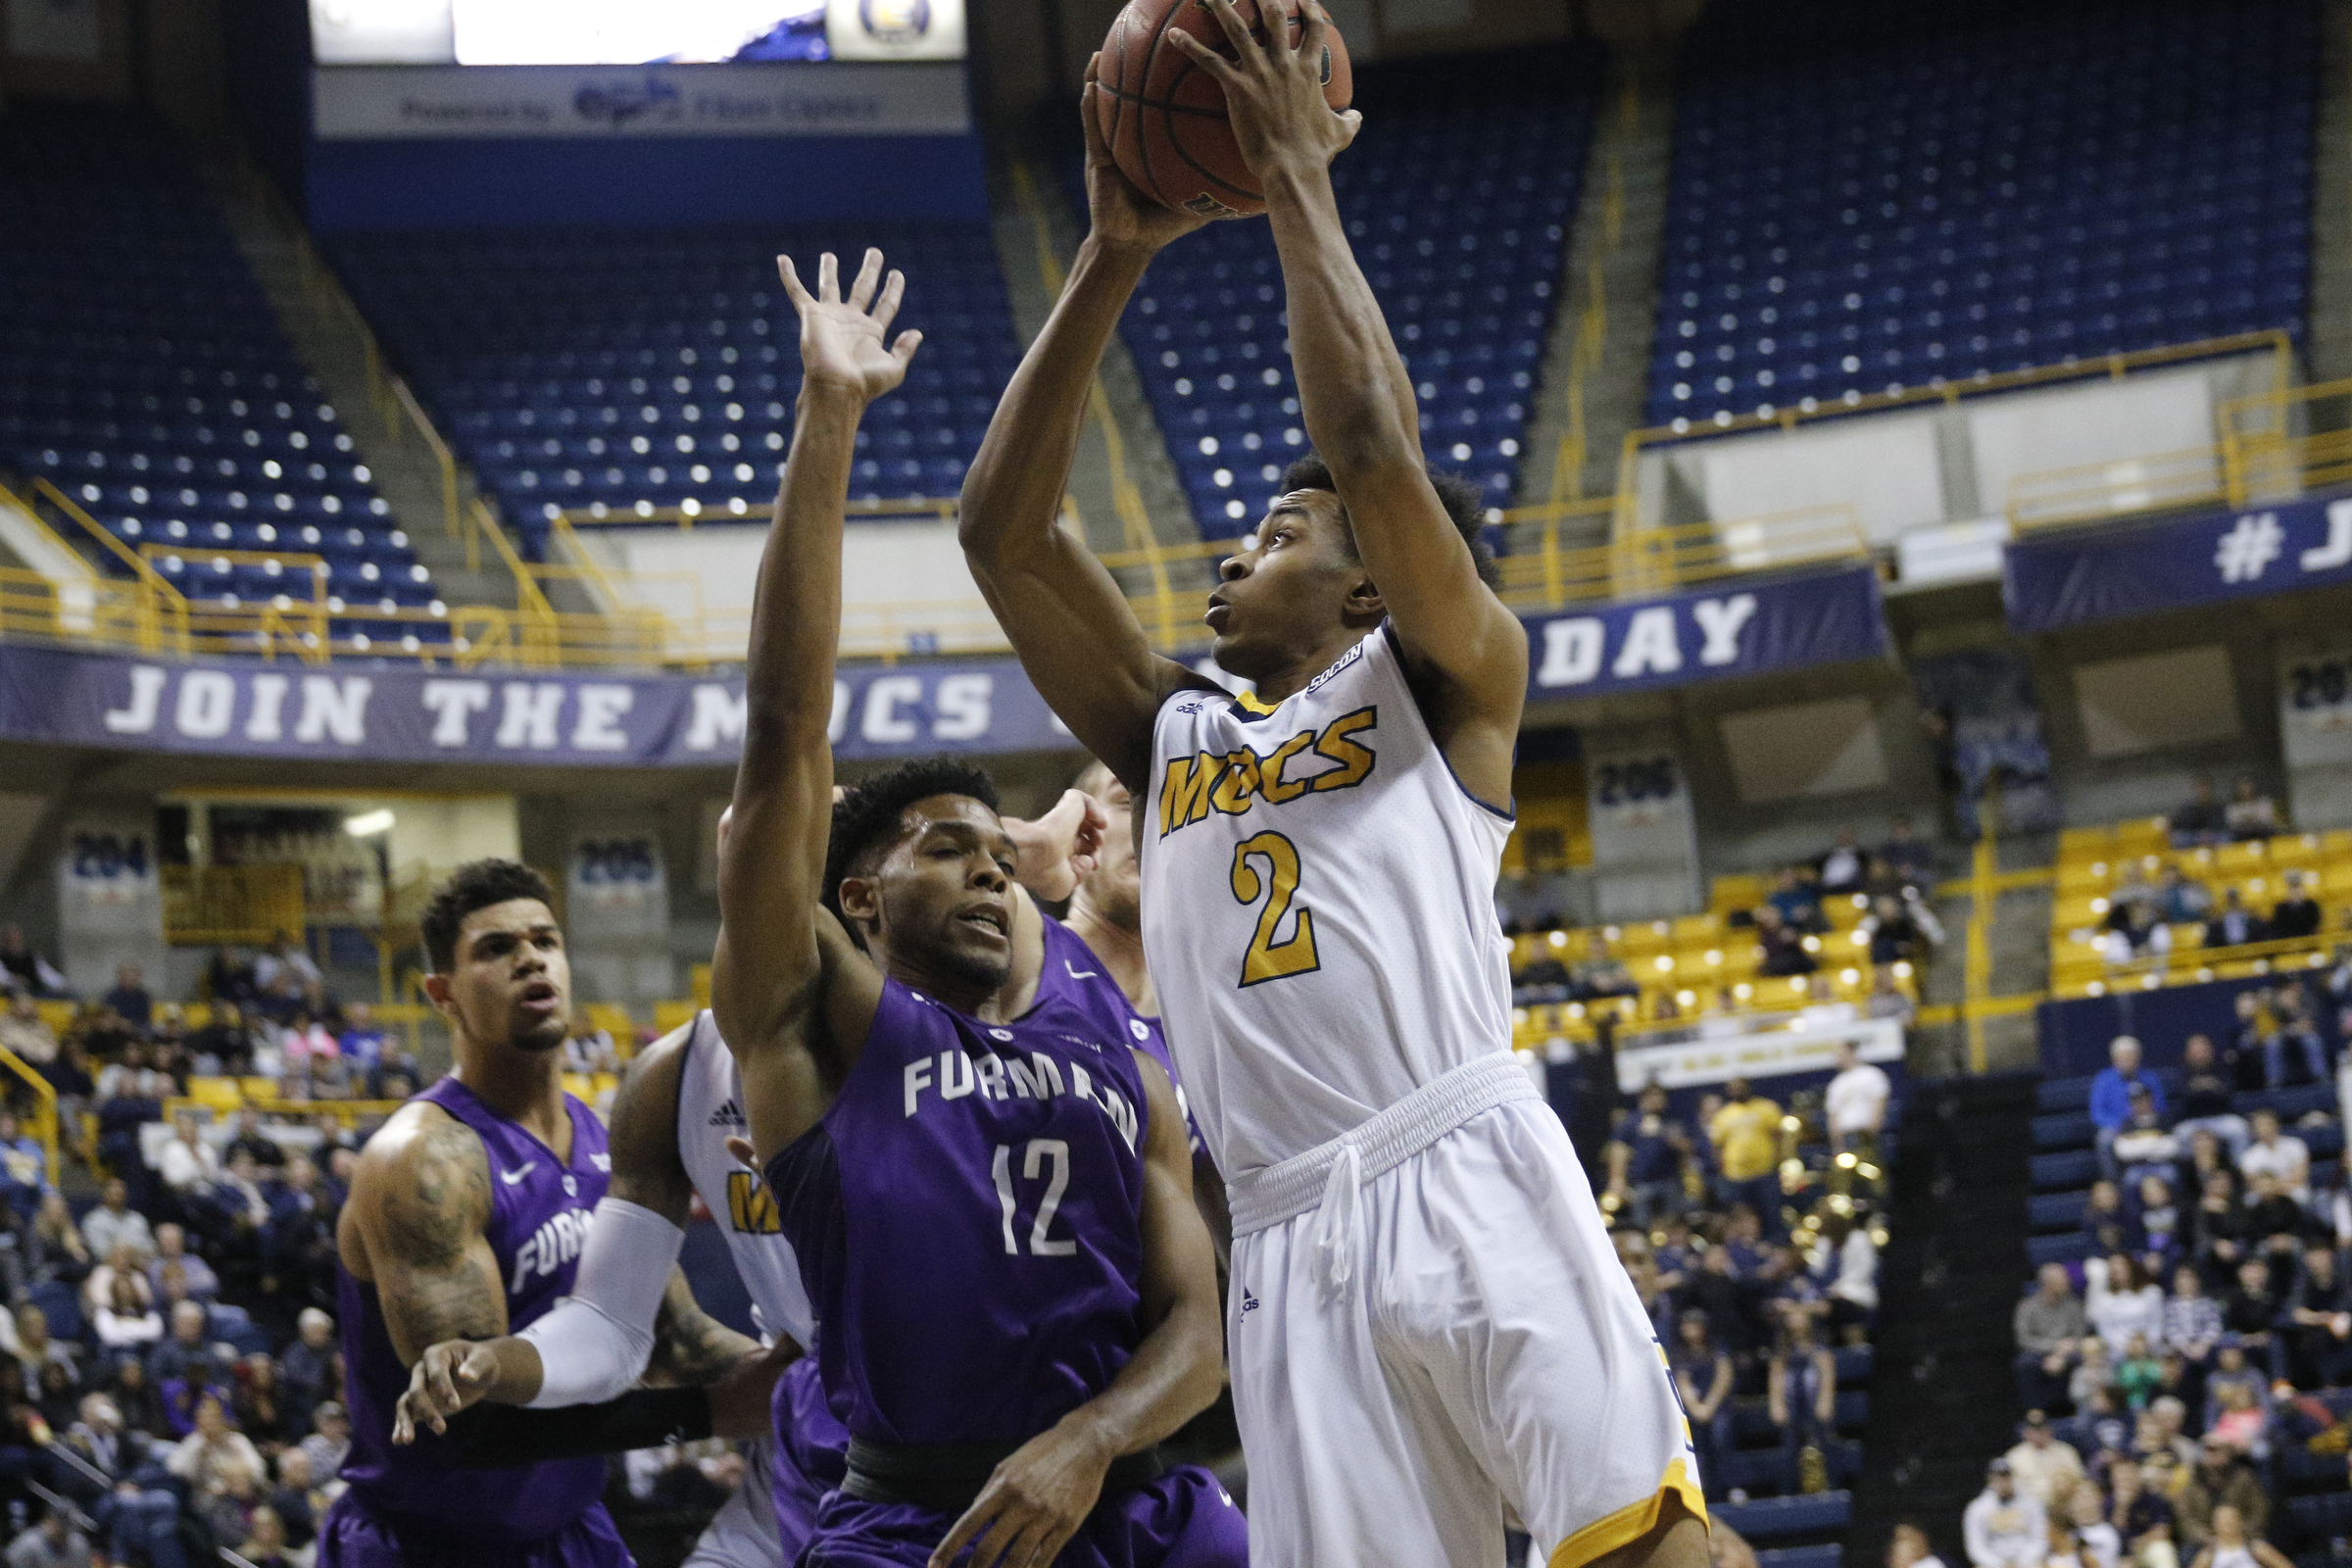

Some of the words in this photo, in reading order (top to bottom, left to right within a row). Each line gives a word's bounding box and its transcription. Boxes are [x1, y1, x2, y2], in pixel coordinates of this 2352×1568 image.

[1306, 640, 1363, 693] SOCON
[1536, 592, 1758, 687] DAY
[105, 663, 372, 746] JOIN
[422, 676, 635, 752] THE
[1158, 704, 1378, 845] MOCS
[1229, 829, 1322, 990] 2
[904, 1049, 1141, 1159] FURMAN
[991, 1138, 1078, 1257] 12
